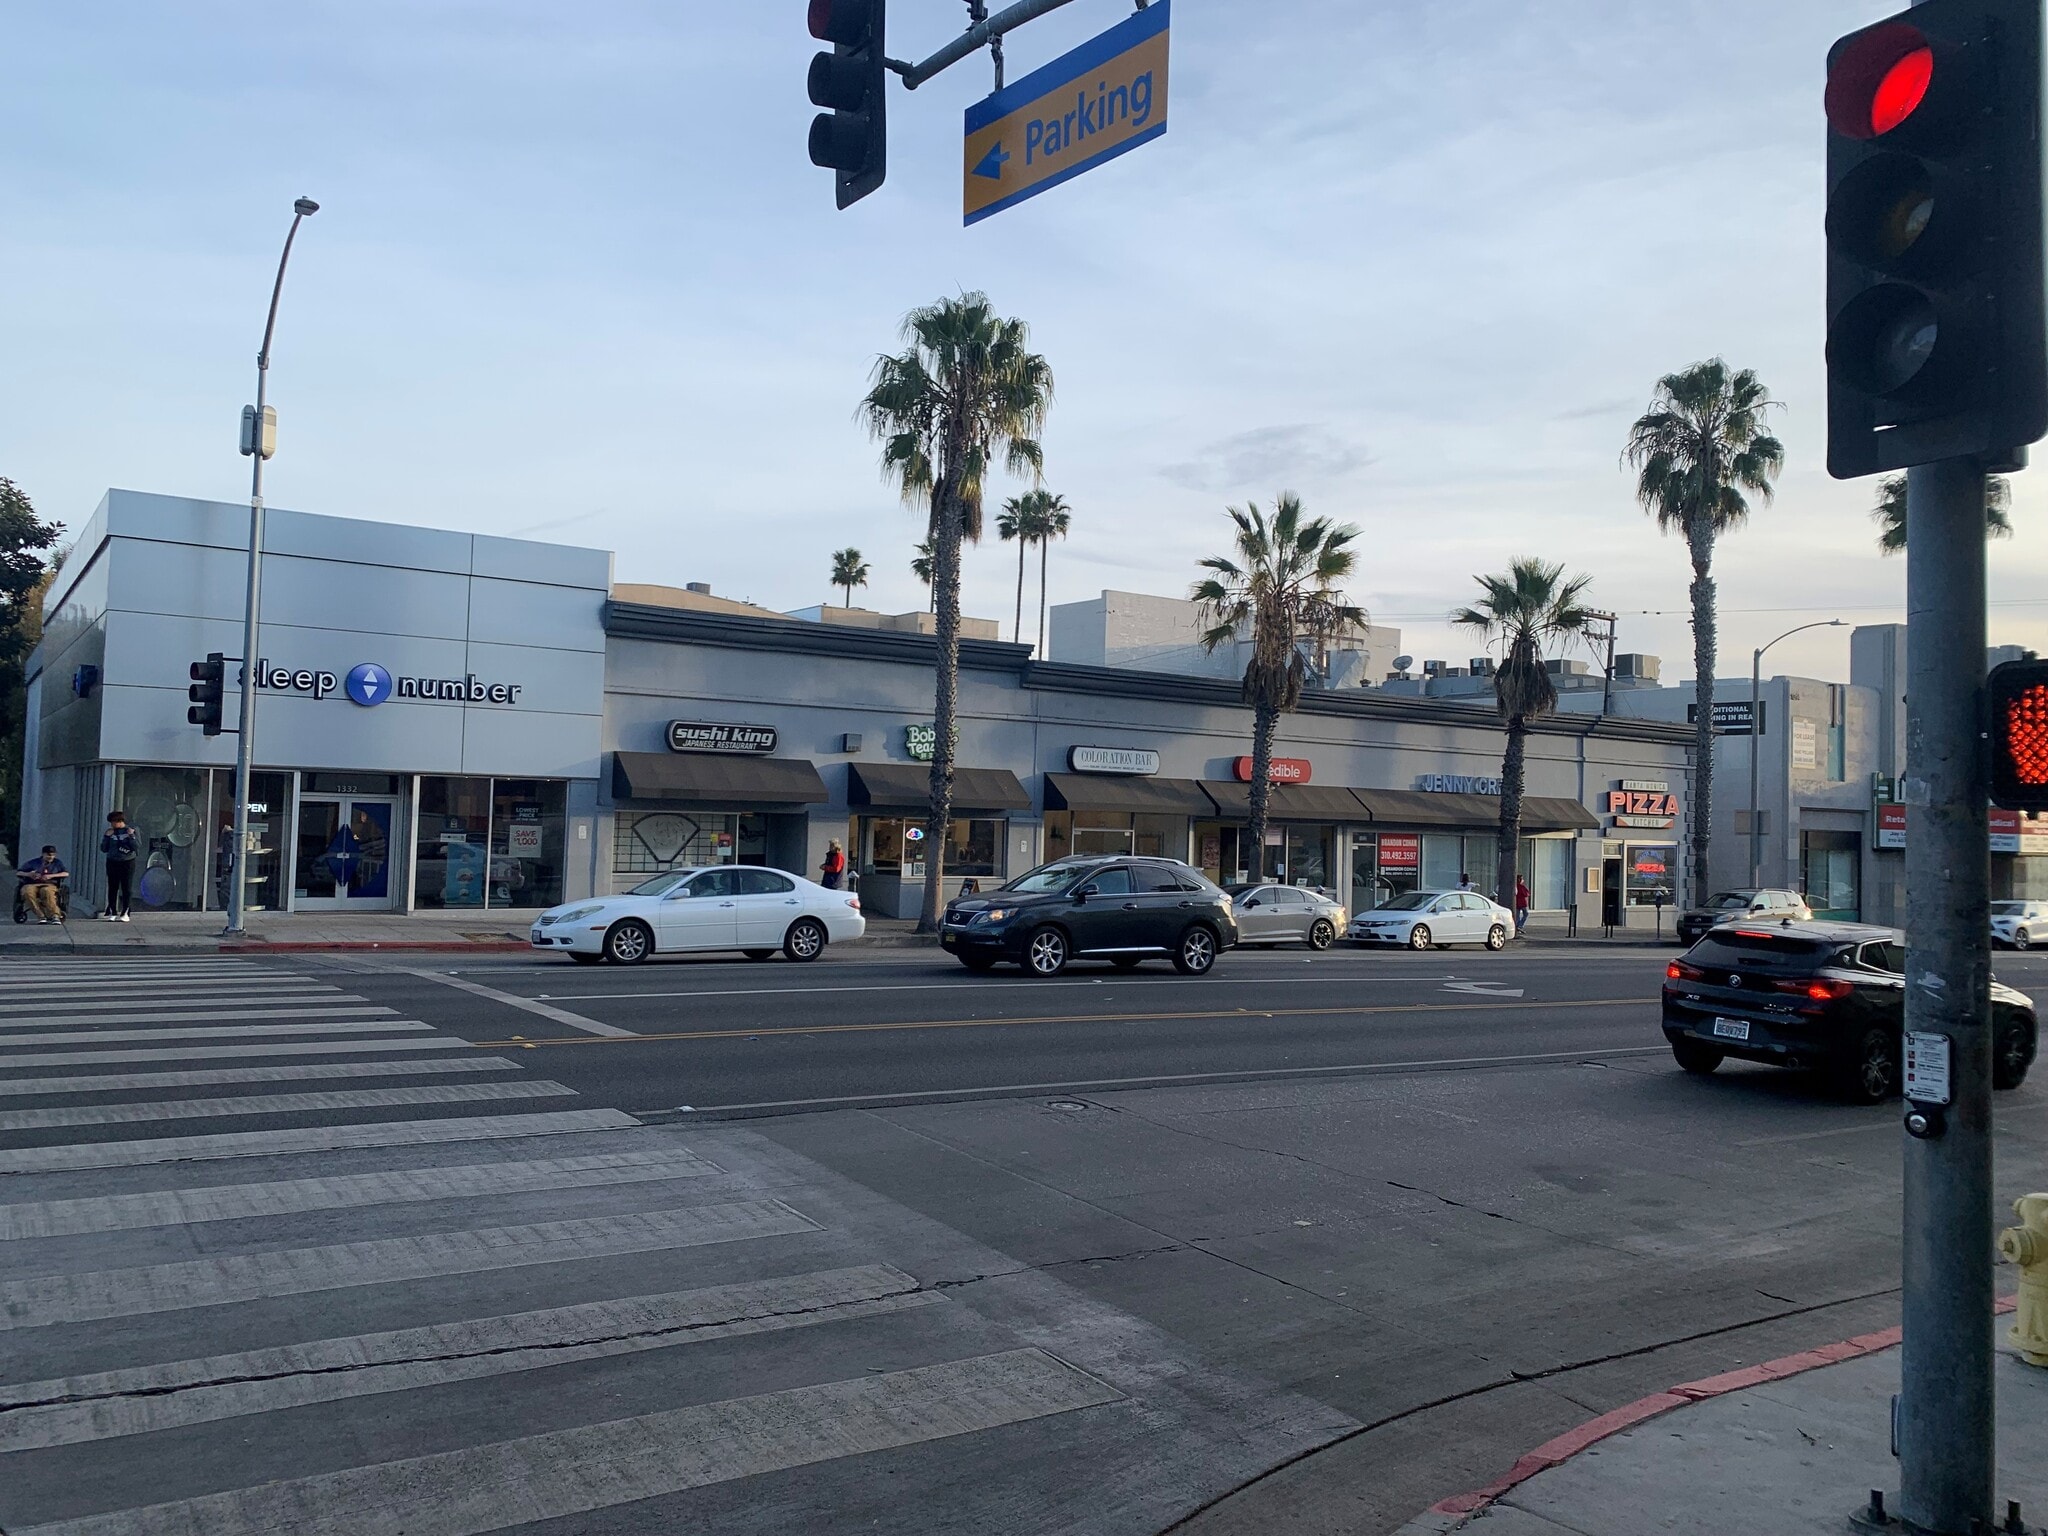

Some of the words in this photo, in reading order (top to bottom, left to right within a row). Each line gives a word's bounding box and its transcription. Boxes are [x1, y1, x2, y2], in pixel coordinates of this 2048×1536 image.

[1026, 70, 1152, 166] Parking
[398, 673, 522, 704] number
[1713, 705, 1749, 713] DITIONAL
[675, 726, 729, 740] sushi
[731, 728, 774, 746] king
[909, 726, 936, 742] Bob
[682, 740, 715, 748] JAPANESE
[716, 742, 758, 750] RESTAURANT
[1081, 750, 1133, 765] COLORATION
[1135, 754, 1153, 766] BAR
[336, 785, 358, 793] 1332
[1424, 774, 1474, 793] JENNY
[247, 803, 267, 812] PEN
[1610, 792, 1680, 816] PIZZA
[1632, 818, 1660, 827] KITCHEN
[1635, 863, 1665, 873] PIZZA
